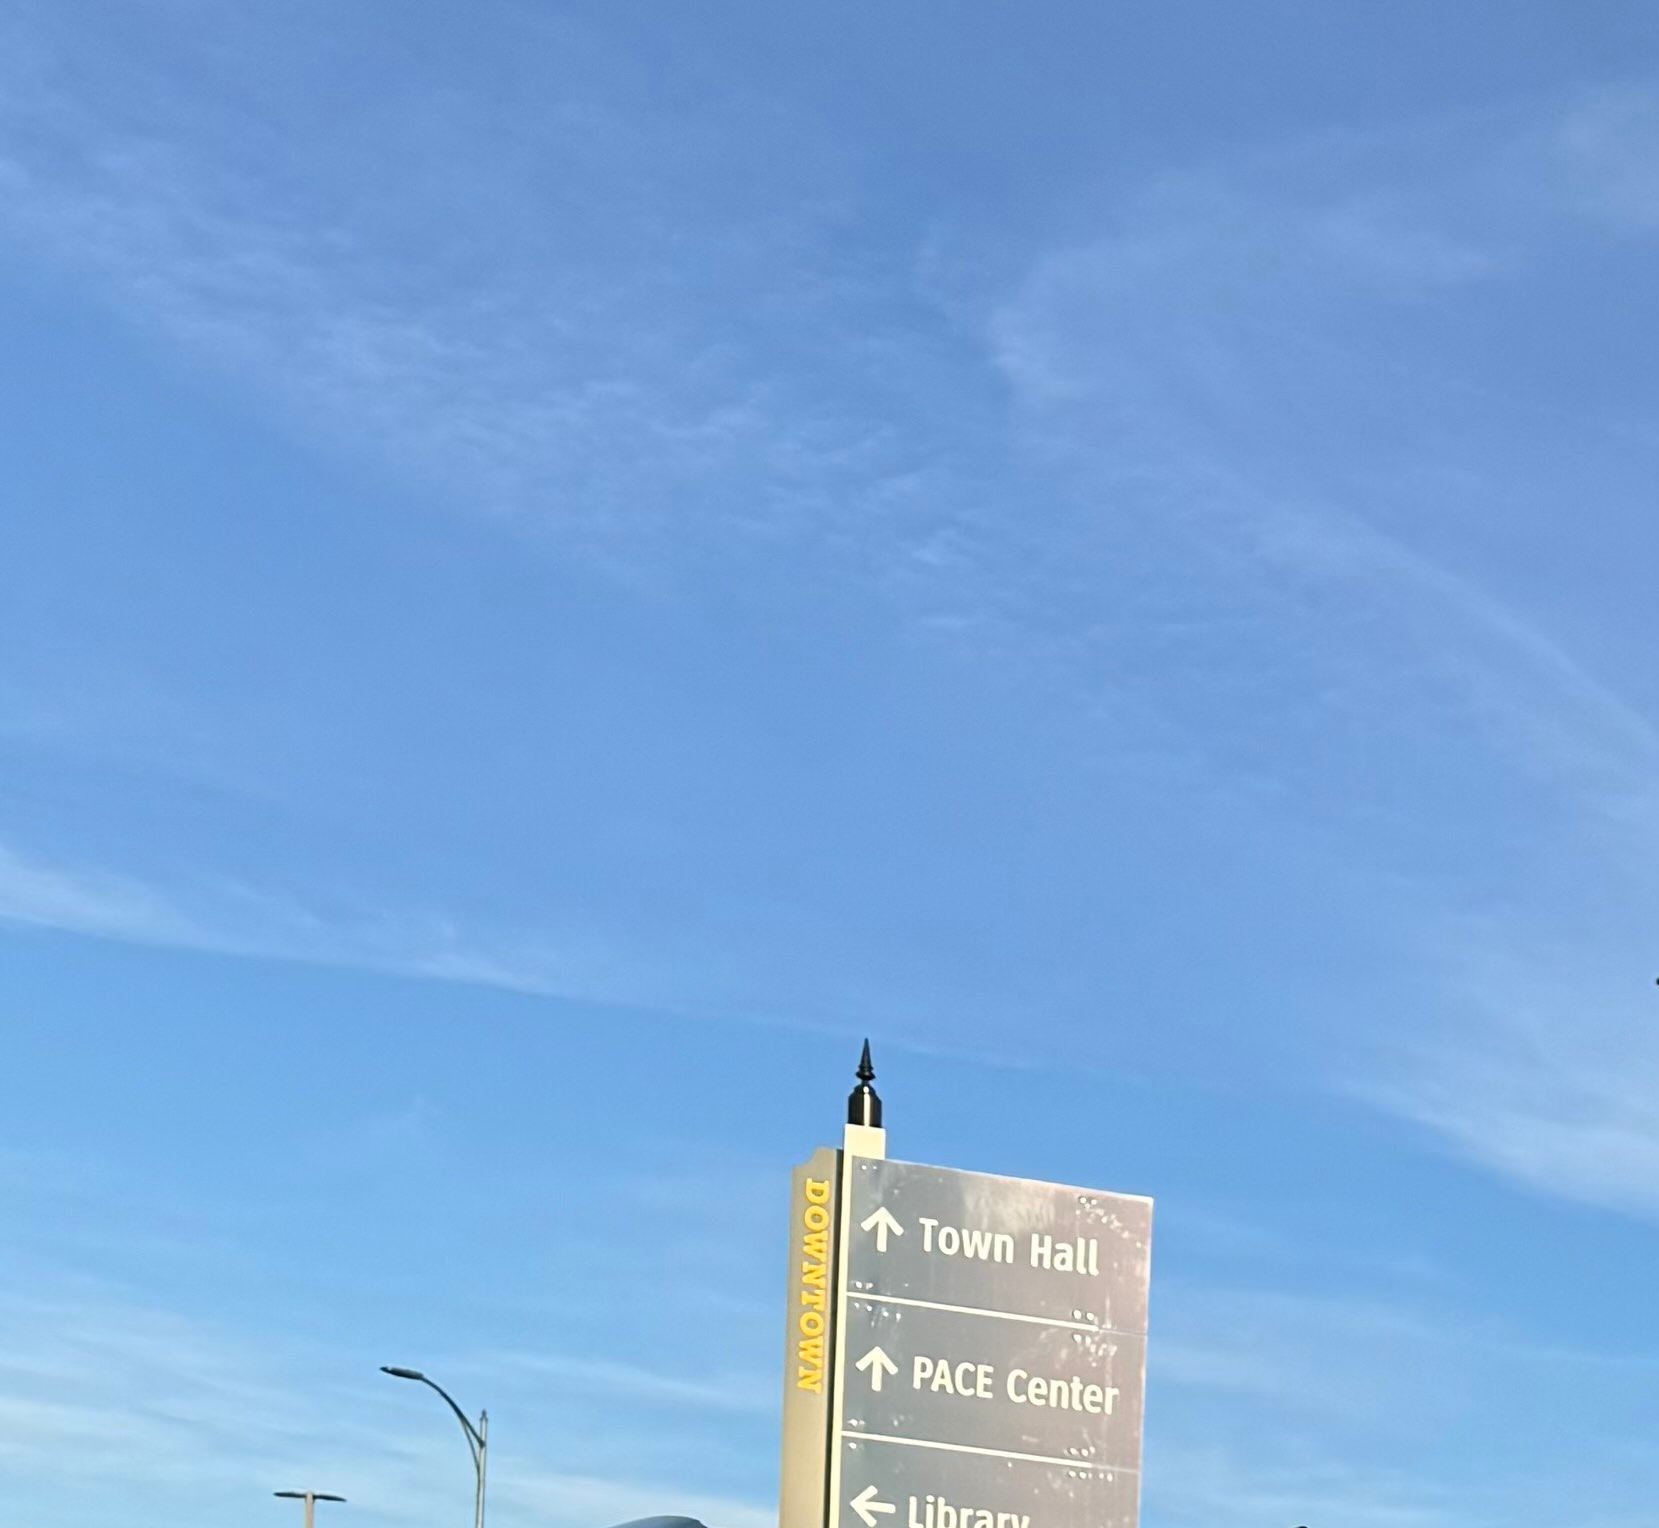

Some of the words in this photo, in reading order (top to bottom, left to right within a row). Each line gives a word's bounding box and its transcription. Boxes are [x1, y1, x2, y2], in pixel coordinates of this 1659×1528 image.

[918, 1217, 1014, 1264] Town
[1030, 1235, 1099, 1276] Hall
[797, 1178, 829, 1393] DOWNTOWN
[913, 1356, 994, 1399] PACE
[1007, 1369, 1119, 1415] Center
